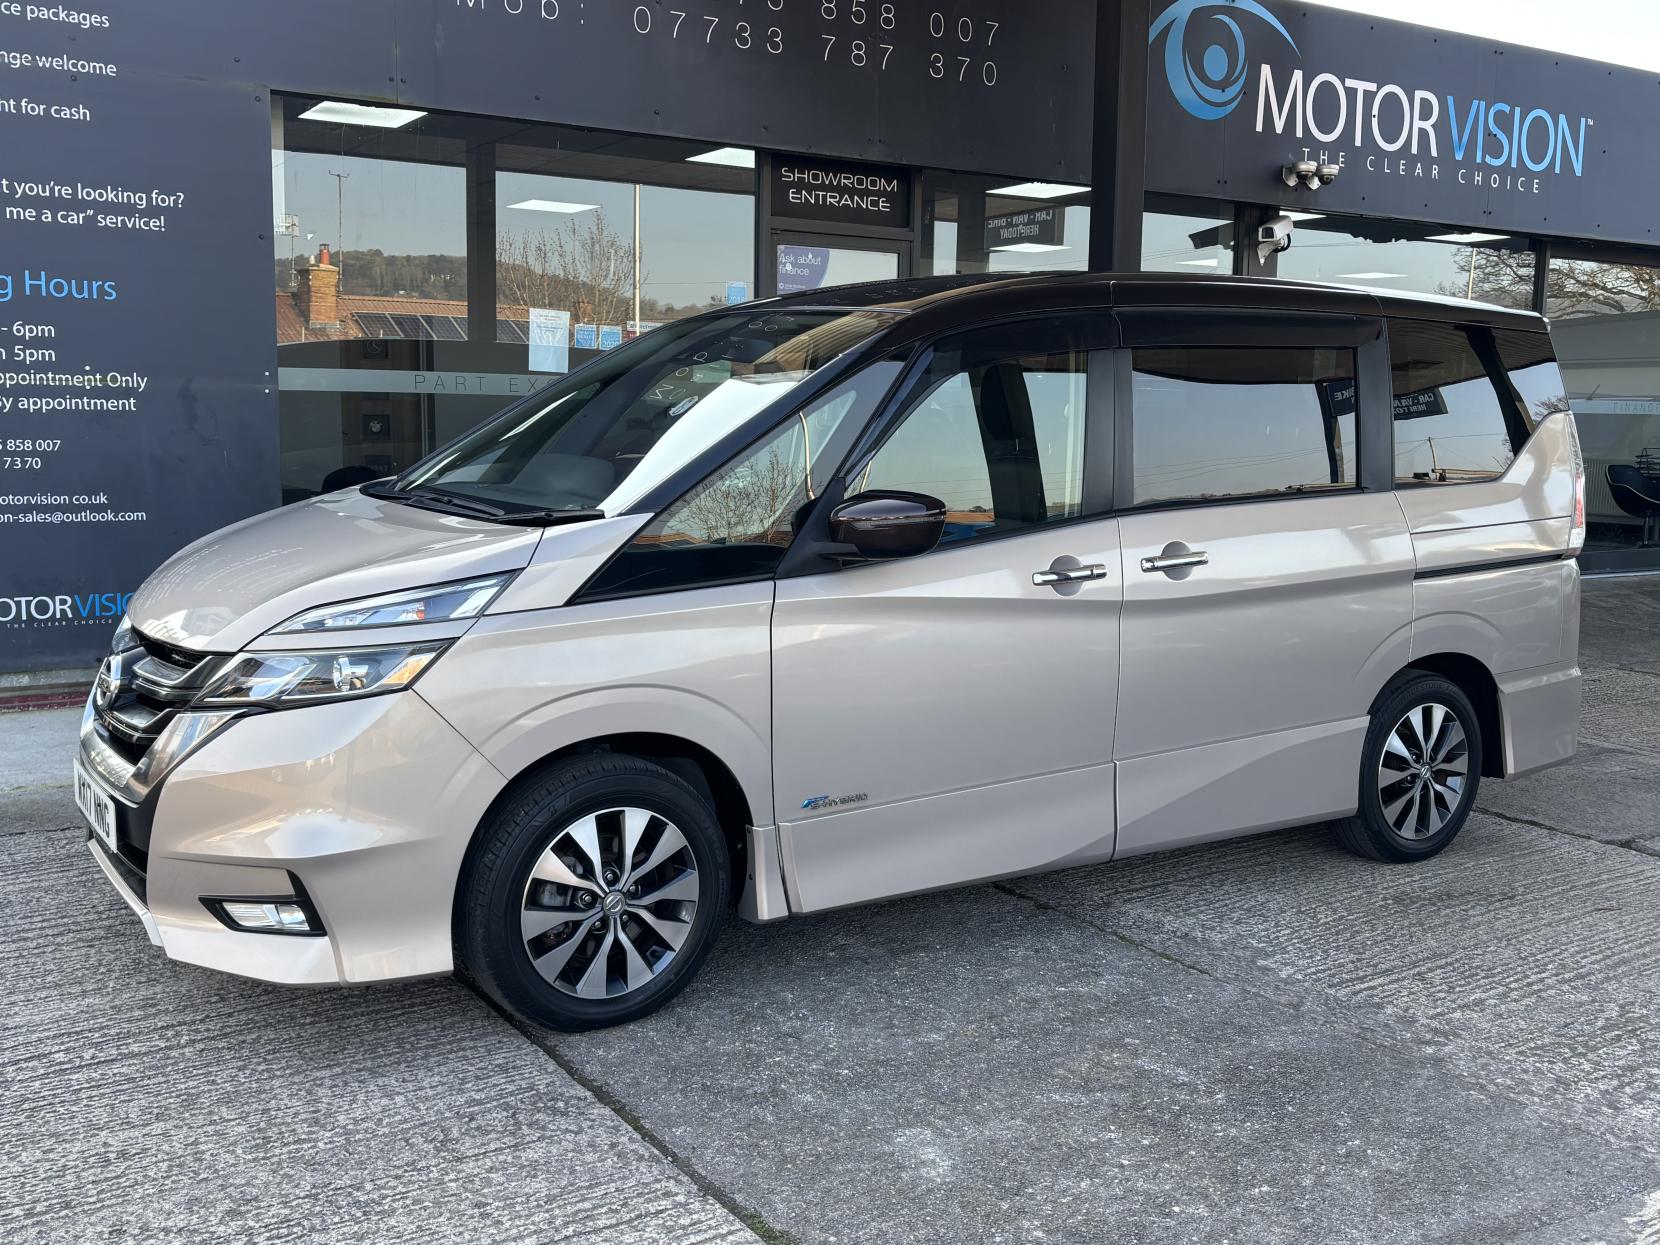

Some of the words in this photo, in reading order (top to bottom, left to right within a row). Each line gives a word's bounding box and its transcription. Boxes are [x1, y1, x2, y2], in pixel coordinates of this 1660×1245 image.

[26, 4, 110, 29] packages
[929, 12, 999, 47] 007
[633, 6, 783, 54] 07733
[821, 34, 894, 70] 787
[929, 53, 997, 86] 370
[35, 53, 117, 77] welcome
[20, 97, 47, 116] for
[50, 103, 90, 122] cash
[781, 166, 898, 193] SHOWROOM
[1302, 147, 1346, 168] THE
[1367, 156, 1439, 180] CLEAR
[1458, 169, 1541, 193] CHOICE
[77, 182, 147, 209] looking
[150, 189, 185, 208] for?
[788, 188, 891, 212] ENTRANCE
[5, 206, 37, 221] me
[41, 209, 52, 222] a
[97, 213, 165, 232] service!
[797, 252, 821, 265] about
[24, 270, 117, 300] Hours
[12, 320, 55, 341] 6pm
[13, 345, 56, 365] 5pm
[106, 372, 148, 392] Only
[413, 374, 487, 393] PART
[17, 394, 137, 414] appointment
[6, 439, 33, 451] 858
[35, 439, 61, 452] 007
[74, 617, 113, 626] CHOICE
